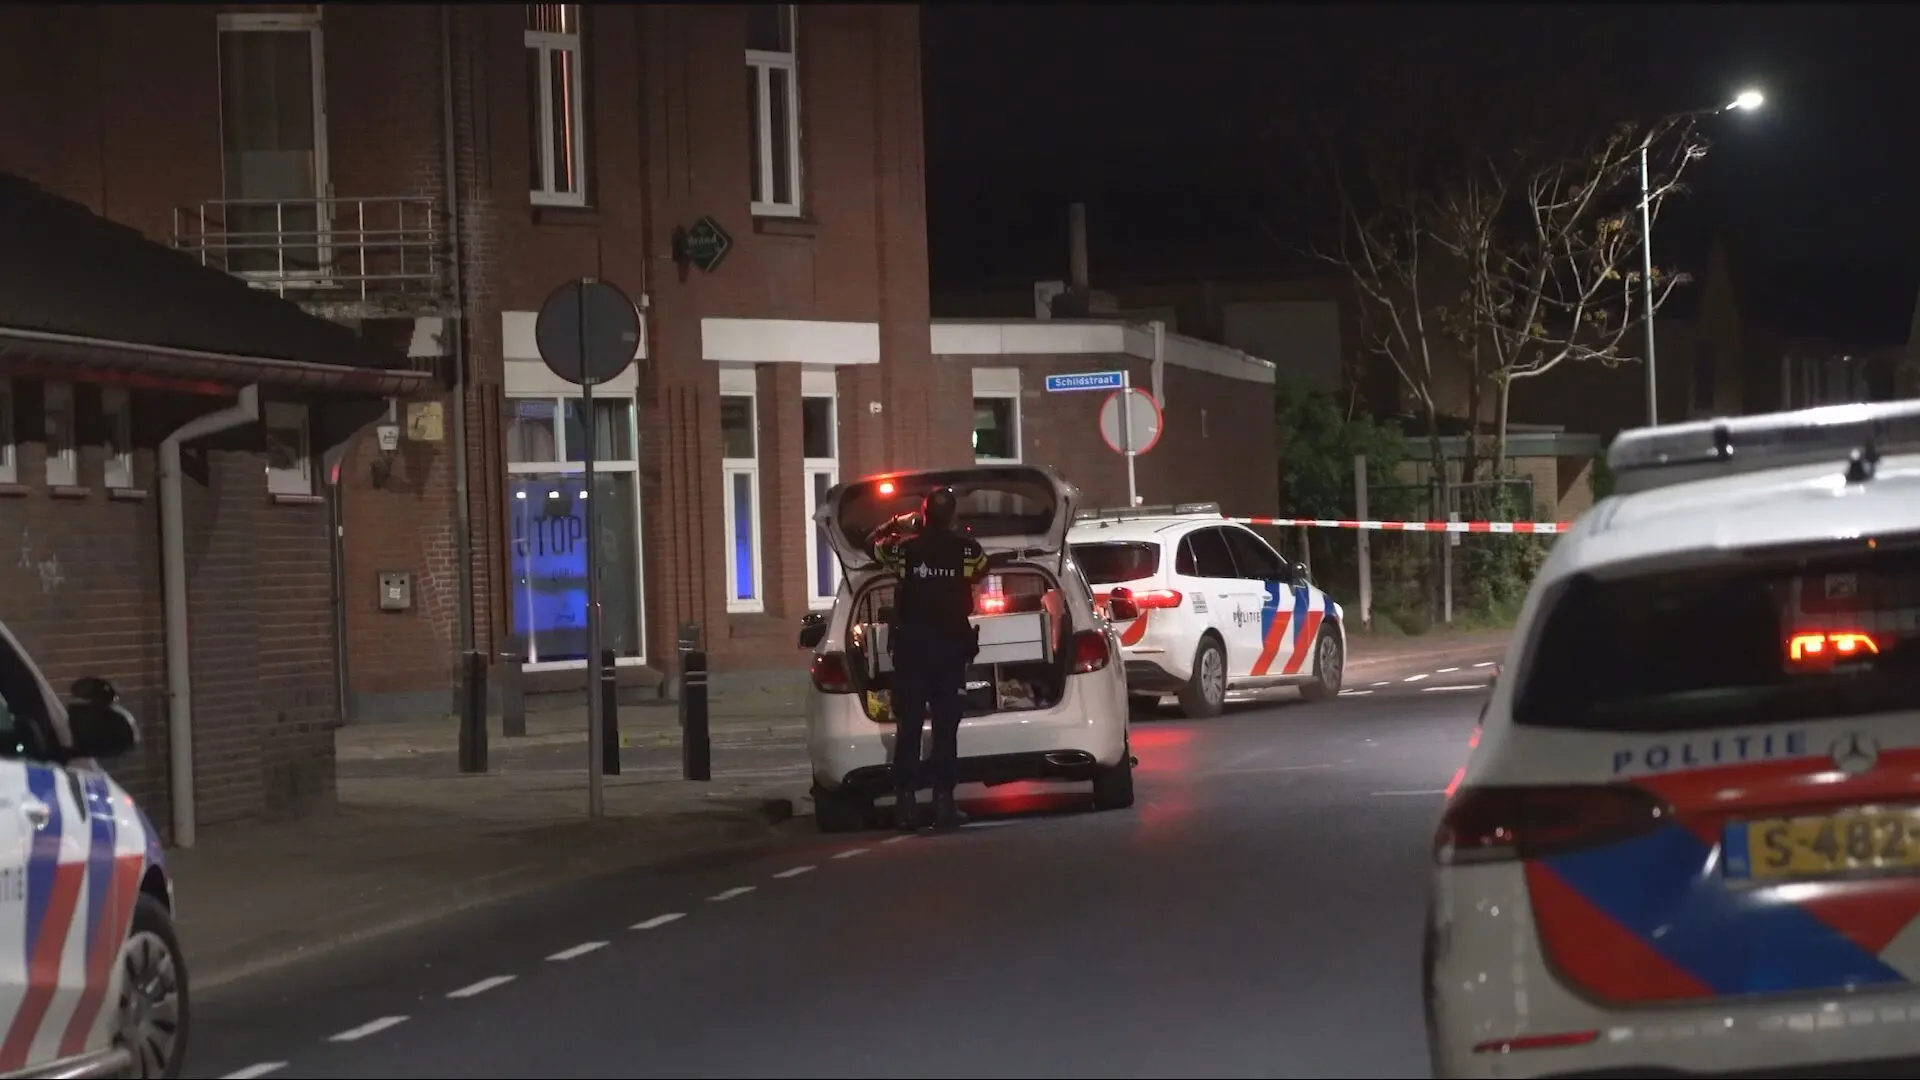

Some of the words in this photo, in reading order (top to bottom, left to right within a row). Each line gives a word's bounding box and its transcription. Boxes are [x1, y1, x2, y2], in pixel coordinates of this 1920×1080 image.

[1055, 376, 1115, 387] Schildstraat
[912, 562, 955, 577] POLITIE
[1612, 731, 1808, 774] POLITIE
